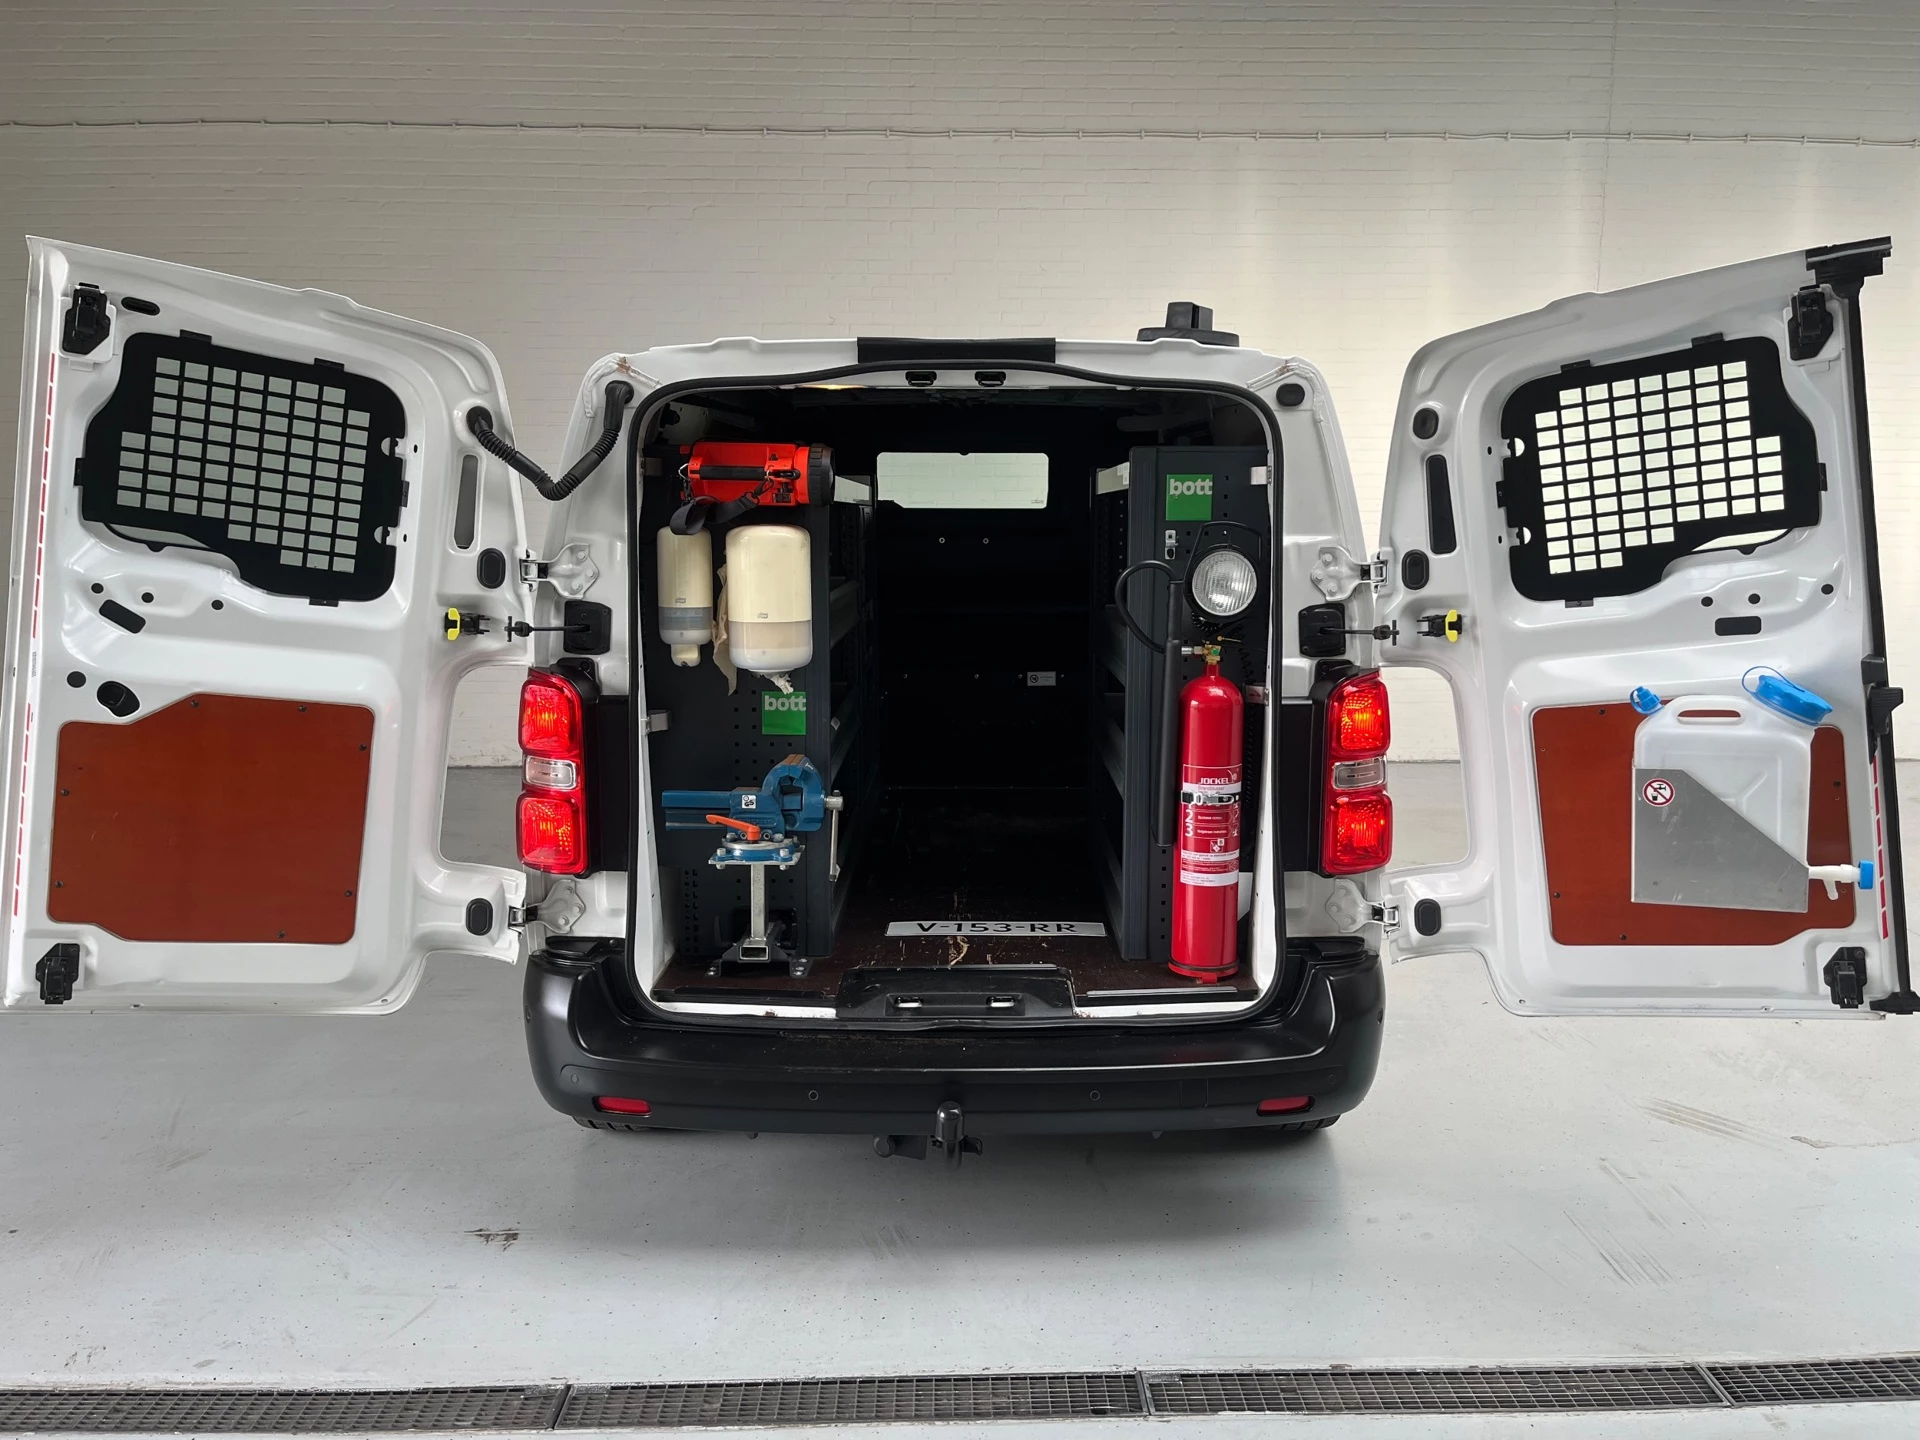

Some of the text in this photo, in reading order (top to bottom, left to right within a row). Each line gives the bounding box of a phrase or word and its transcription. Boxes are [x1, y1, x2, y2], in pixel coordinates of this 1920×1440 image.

[1169, 479, 1213, 495] bott
[764, 695, 806, 711] bott
[1185, 809, 1194, 823] 2
[1185, 823, 1194, 837] 3
[916, 922, 1077, 933] V-153-RR
